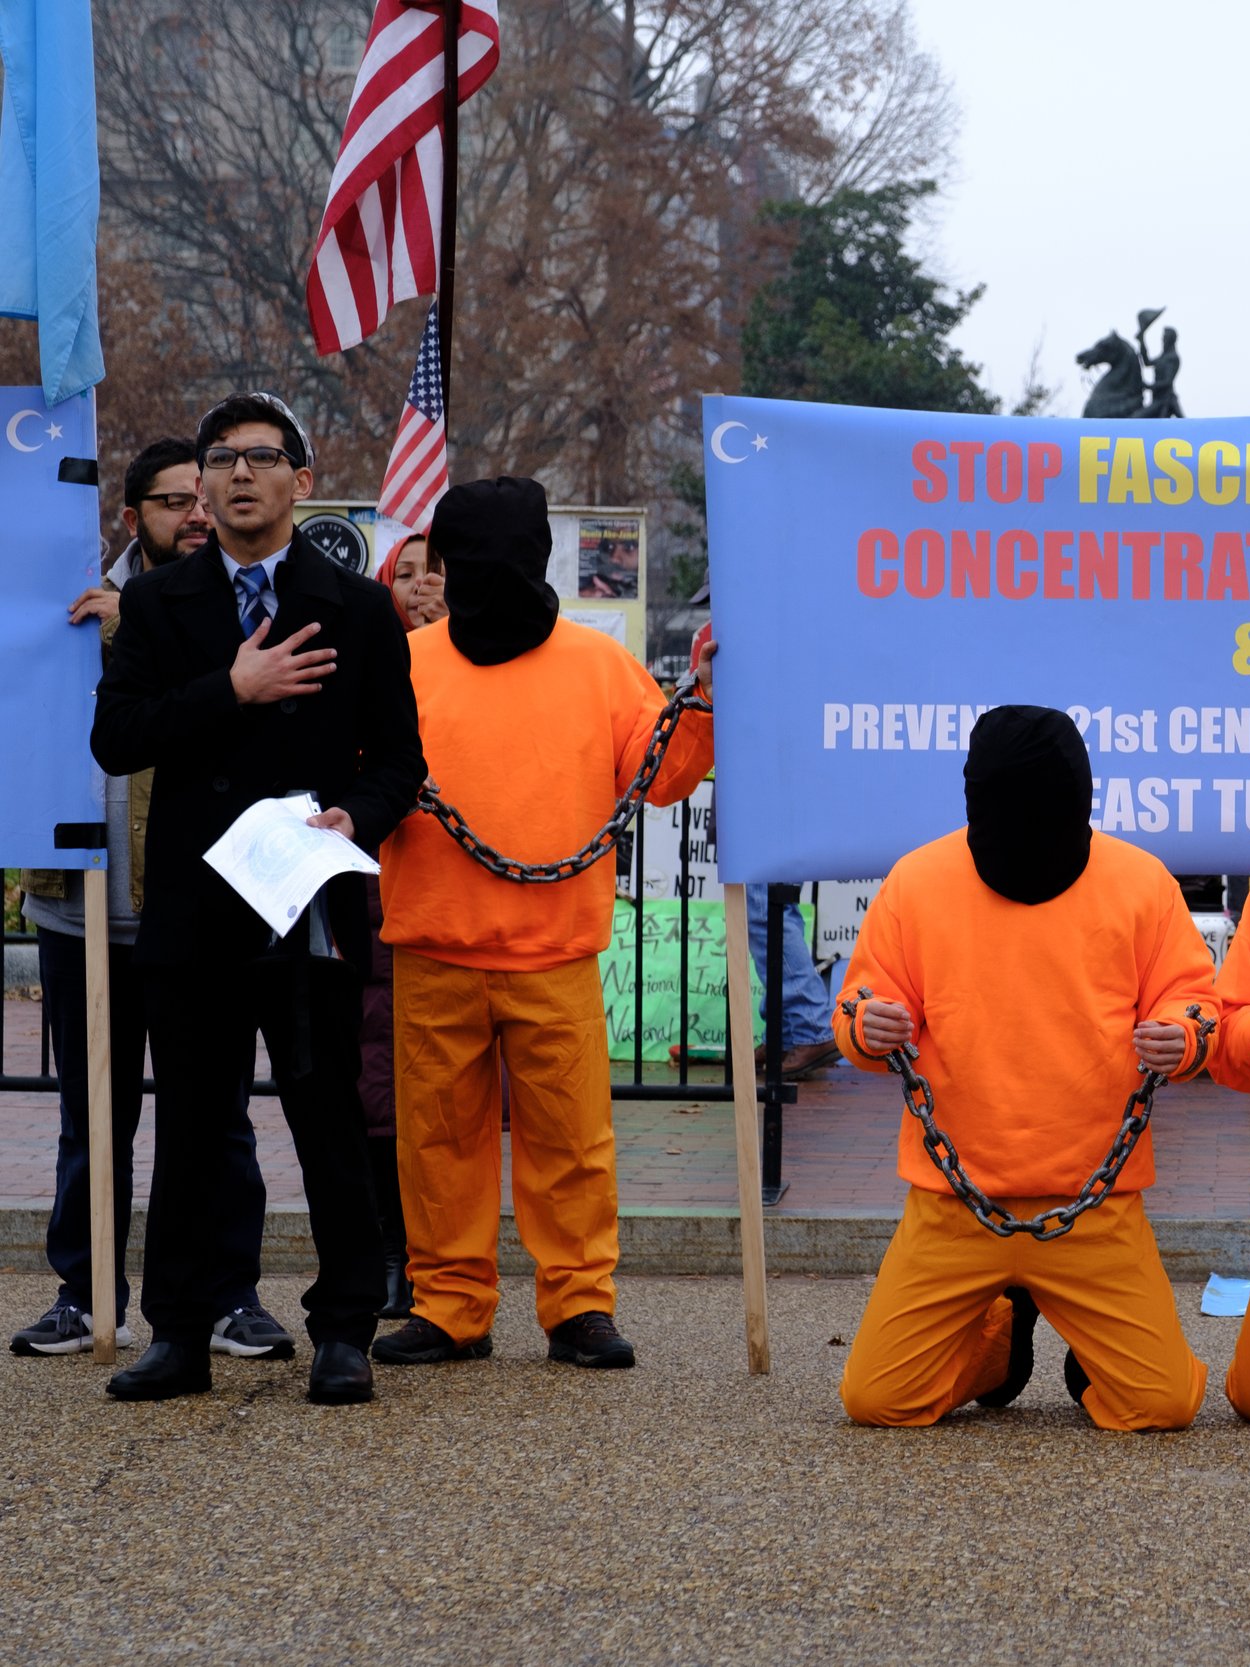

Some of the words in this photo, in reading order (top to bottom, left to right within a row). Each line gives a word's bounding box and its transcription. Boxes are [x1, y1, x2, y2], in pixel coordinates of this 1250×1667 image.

[913, 441, 1062, 504] STOP
[336, 546, 349, 560] W
[823, 703, 1000, 751] PREVEN
[1065, 705, 1158, 753] 21st
[602, 960, 680, 996] Naional
